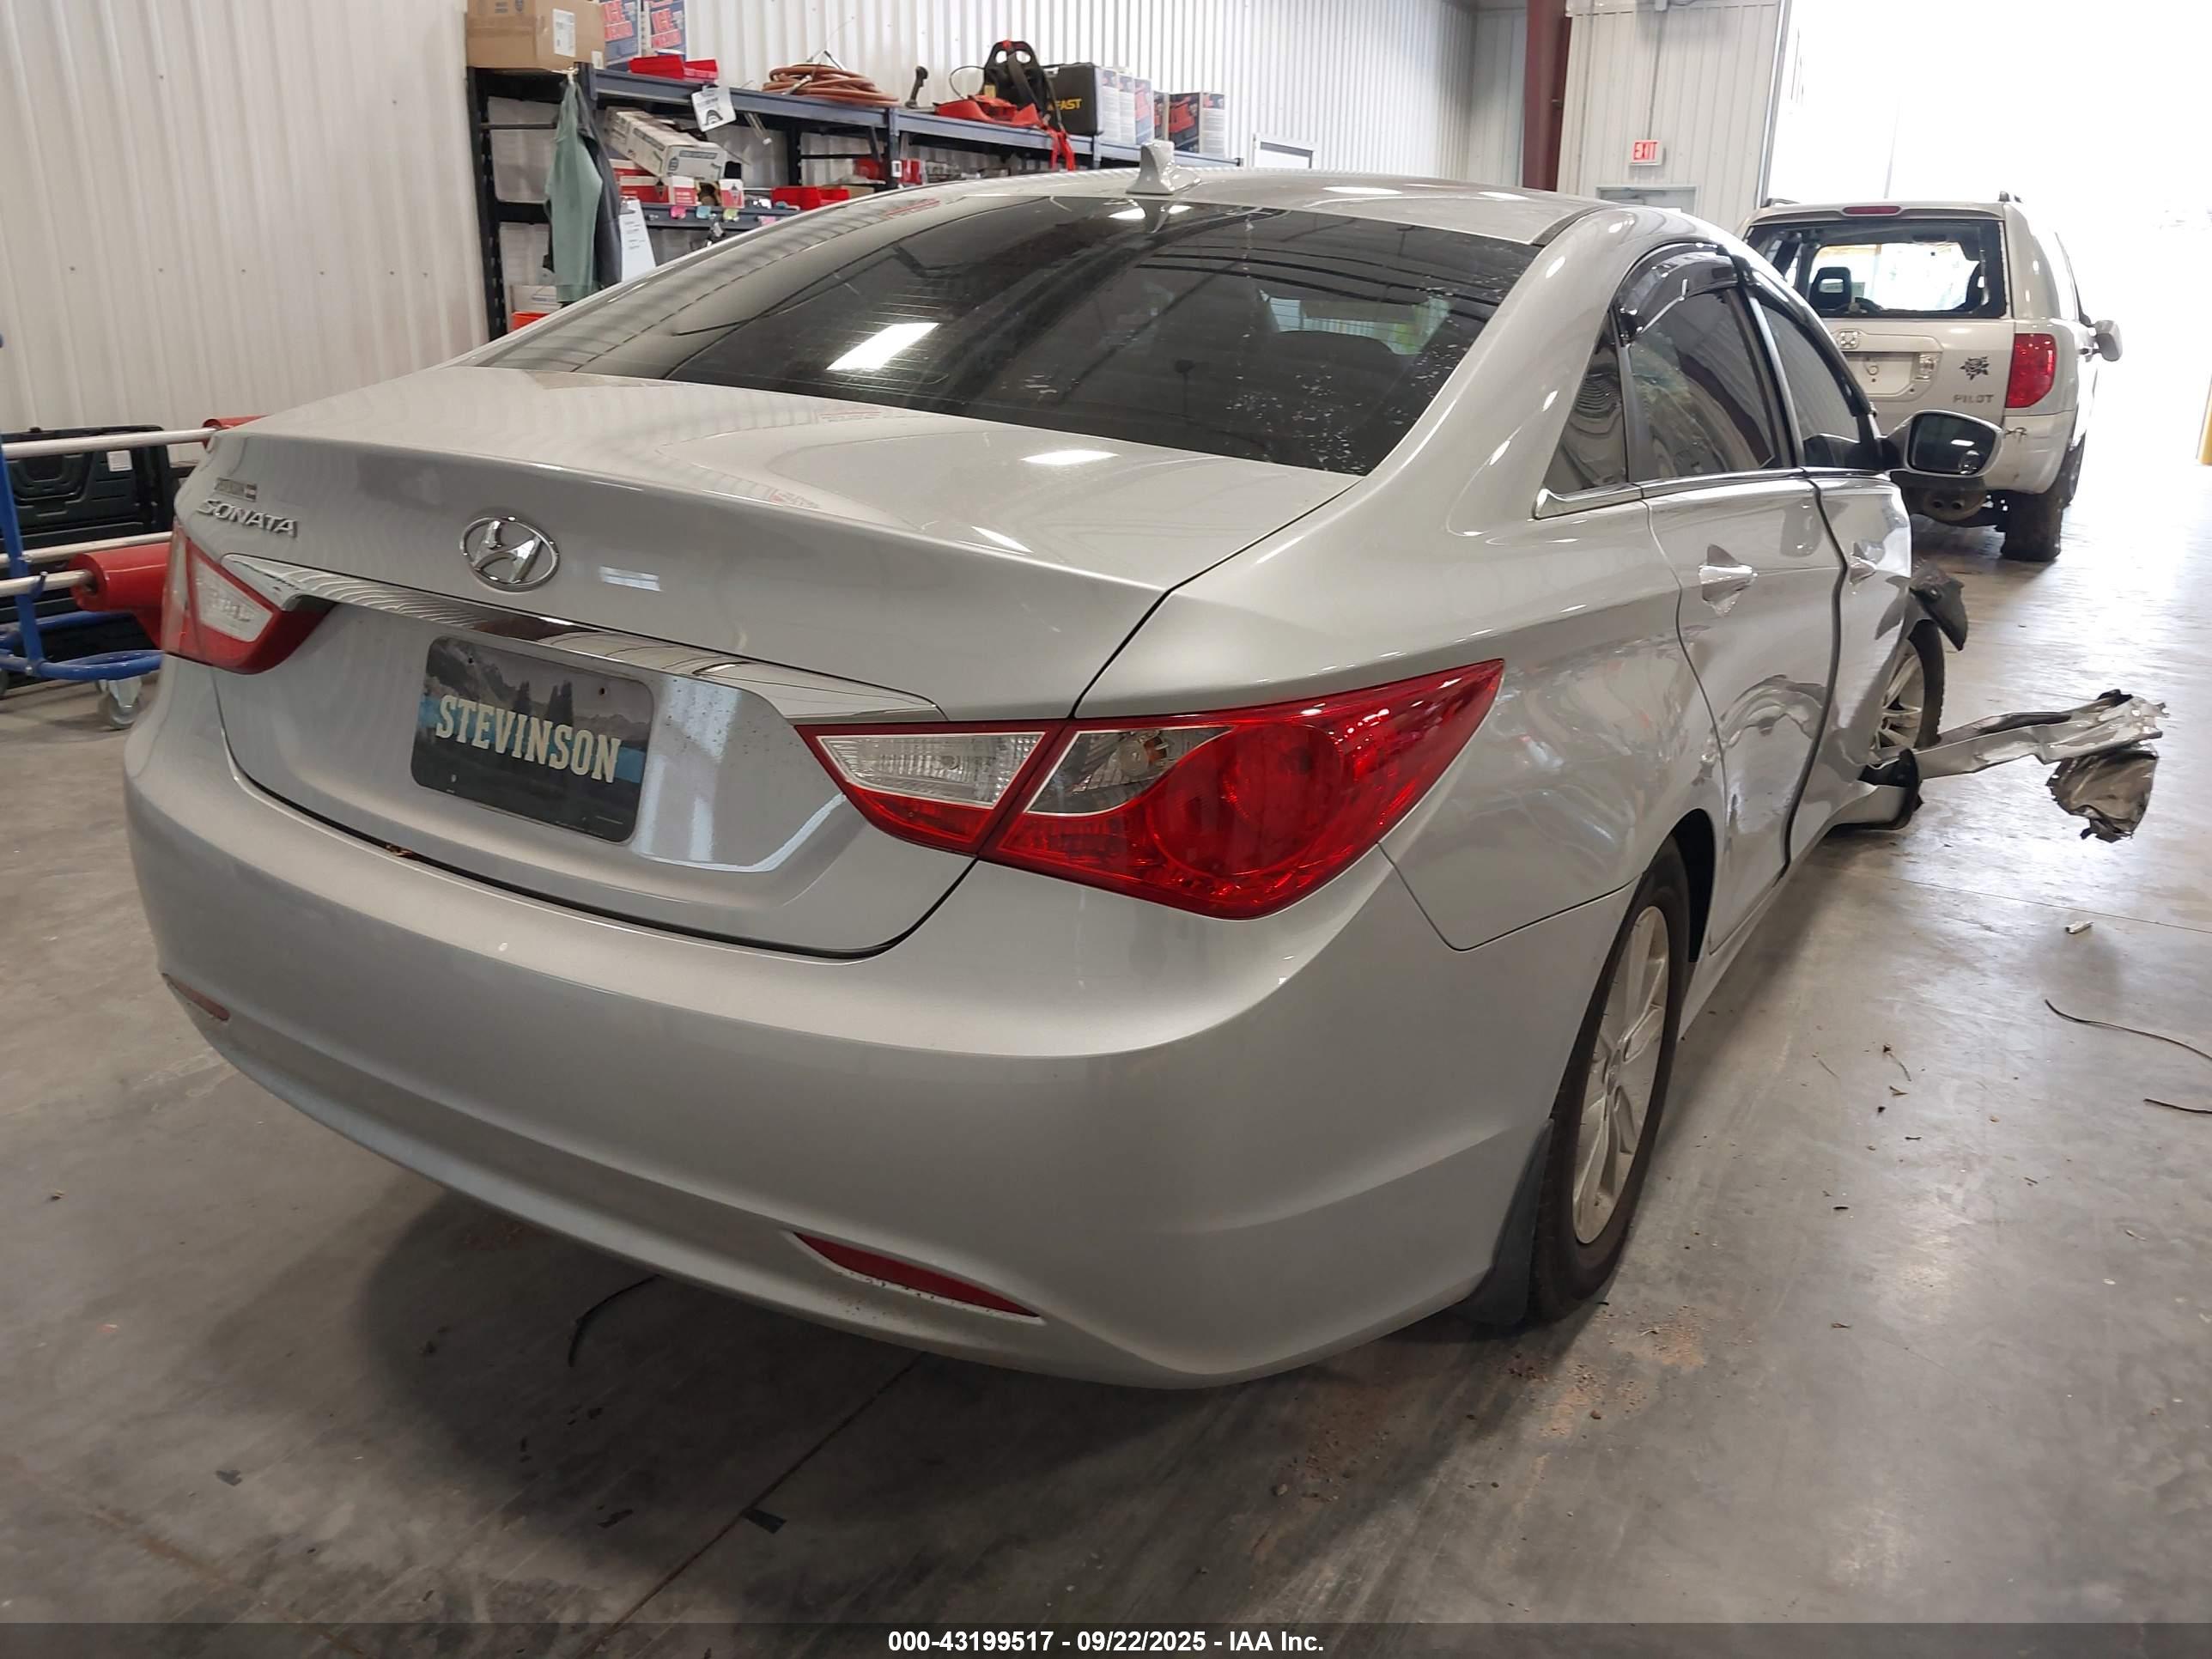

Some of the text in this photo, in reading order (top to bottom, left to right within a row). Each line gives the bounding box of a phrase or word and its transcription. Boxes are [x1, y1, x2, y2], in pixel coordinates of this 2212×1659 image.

[1633, 141, 1658, 161] EXIT
[1953, 394, 1995, 404] PILOT
[196, 499, 298, 539] SONATA
[434, 694, 623, 783] STEVINSON
